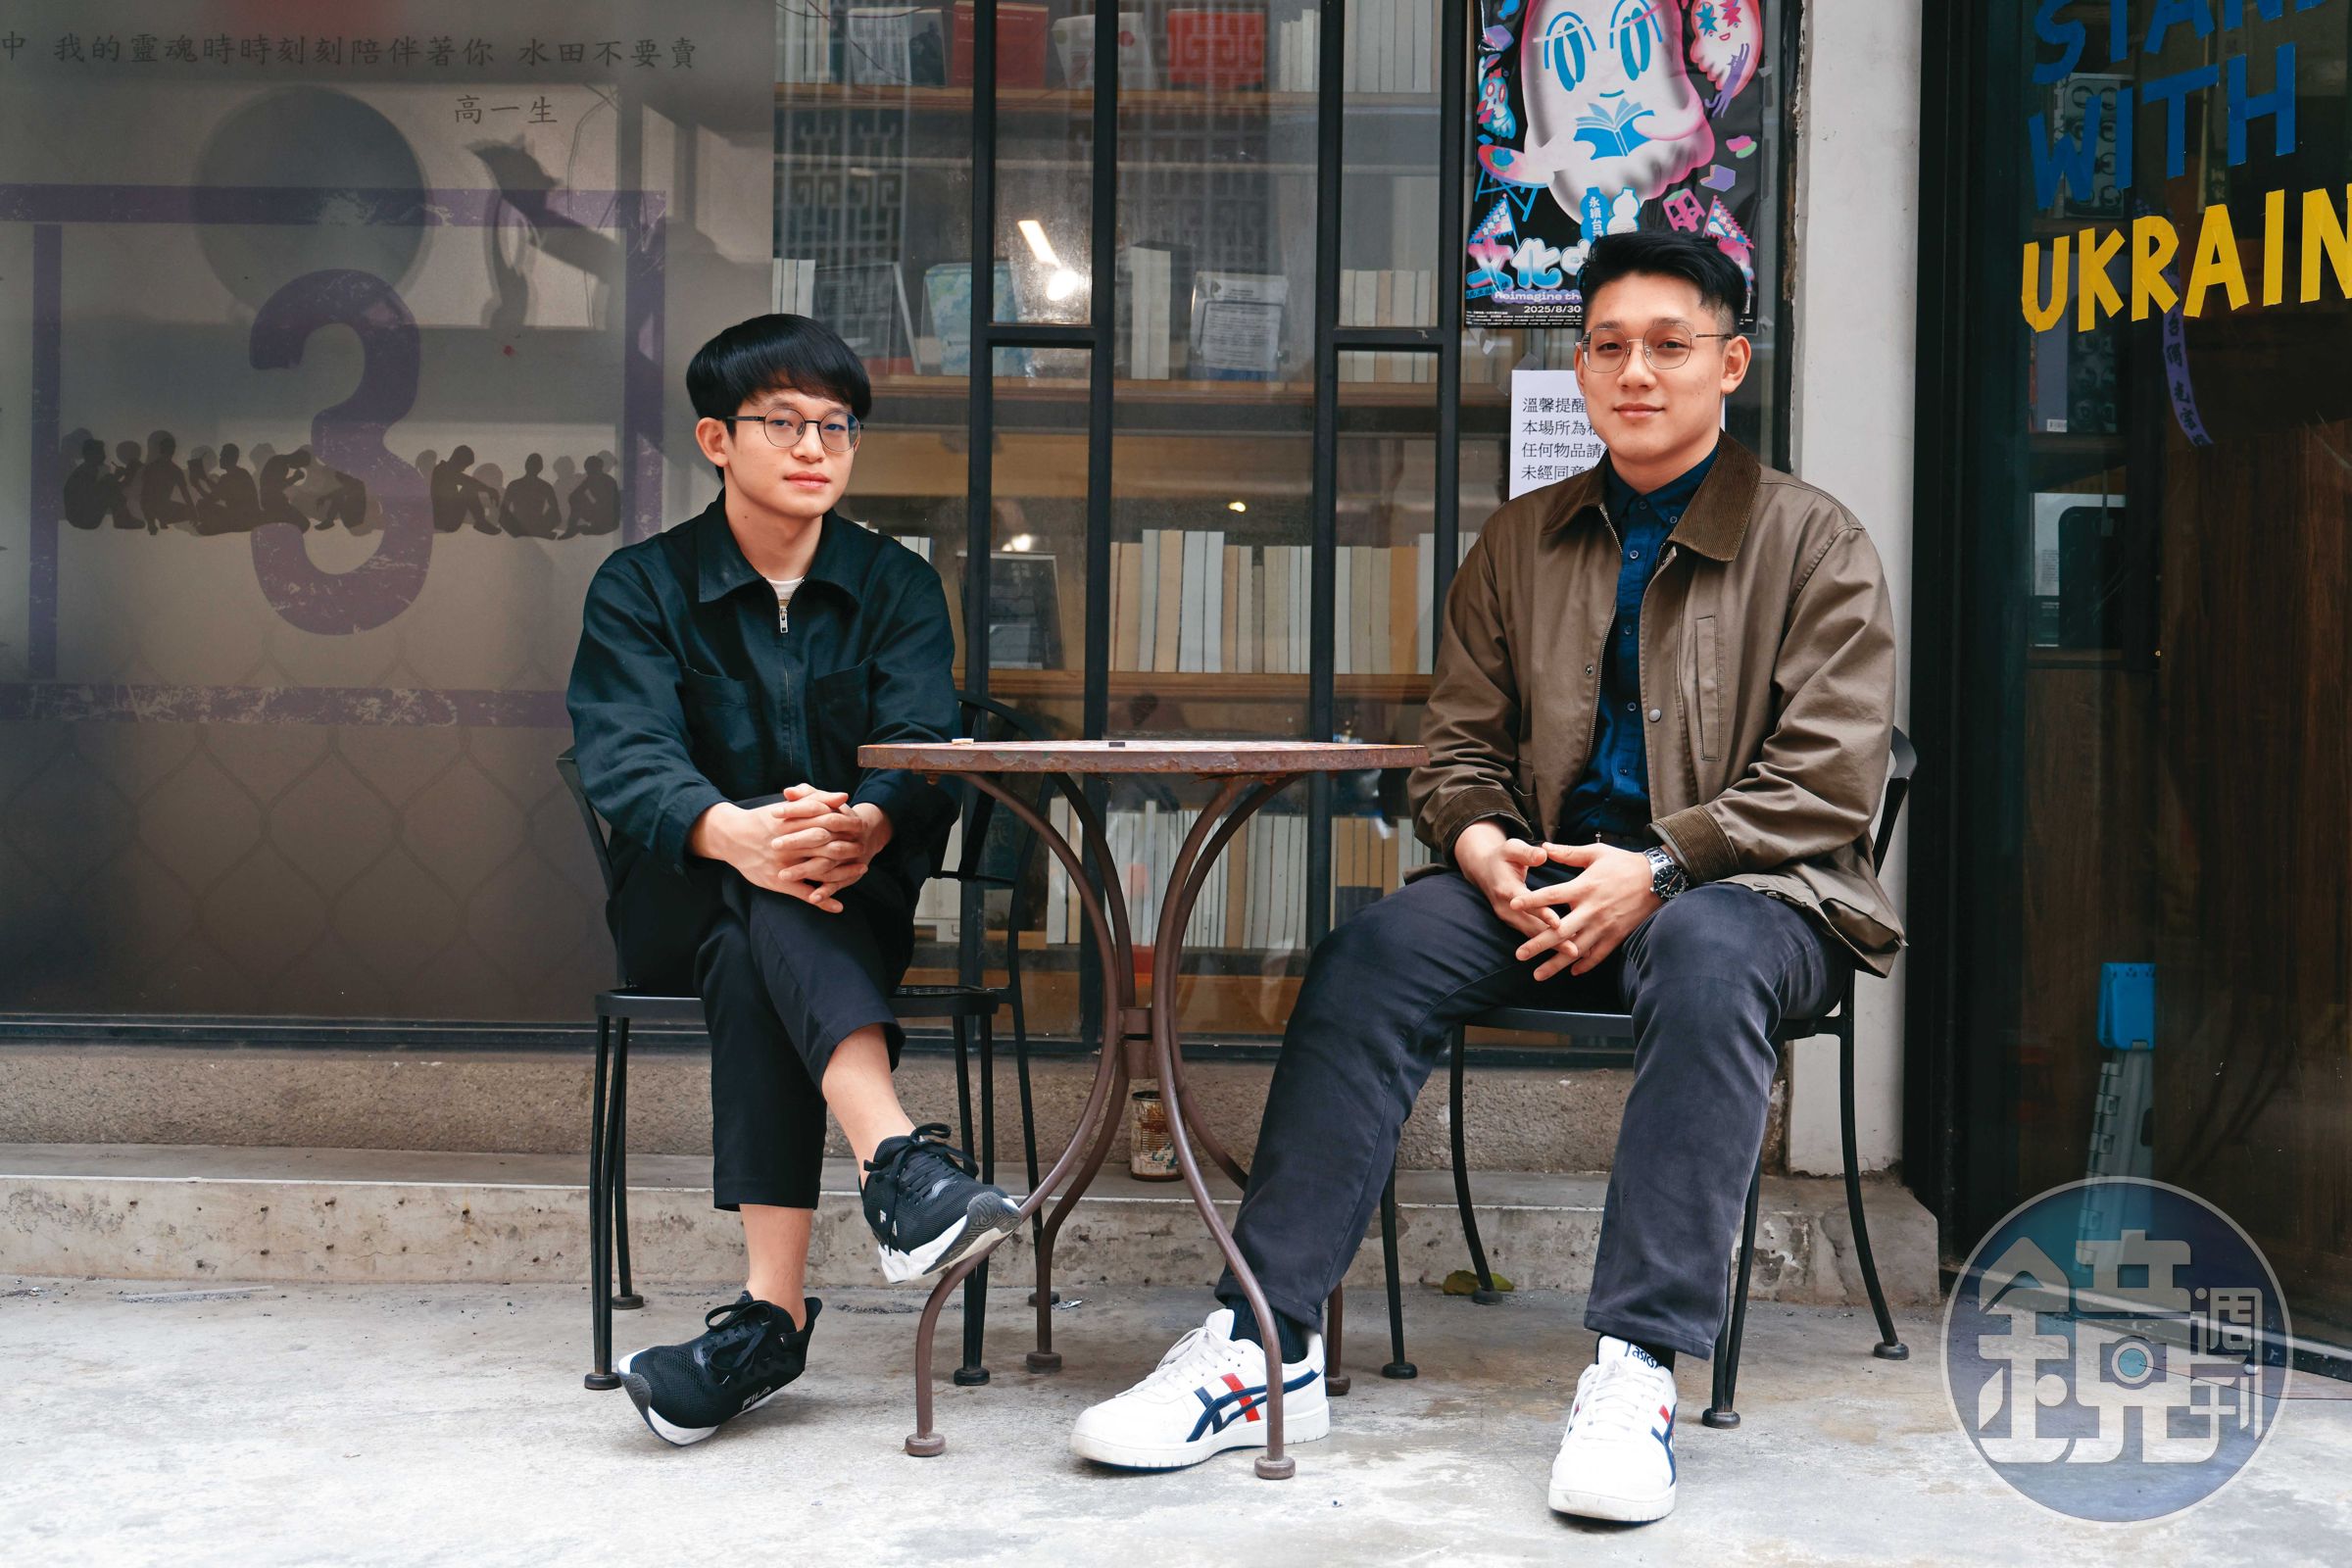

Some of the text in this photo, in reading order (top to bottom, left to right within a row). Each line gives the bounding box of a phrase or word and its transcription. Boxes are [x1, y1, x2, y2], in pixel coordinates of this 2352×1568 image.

[1, 30, 697, 70] 中 我的靈魂時時刻刻陪伴著你 水田不要賣
[454, 94, 558, 125] 高一生
[2028, 42, 2296, 210] WITH
[2020, 183, 2352, 333] UKRAIN
[1565, 291, 1583, 301] th
[1523, 305, 1582, 314] 2025/8/30
[1522, 397, 1587, 414] 溫馨提醒
[1521, 442, 1607, 459] 任何物品請
[1631, 1346, 1655, 1369] asics
[741, 1386, 772, 1410] FILA
